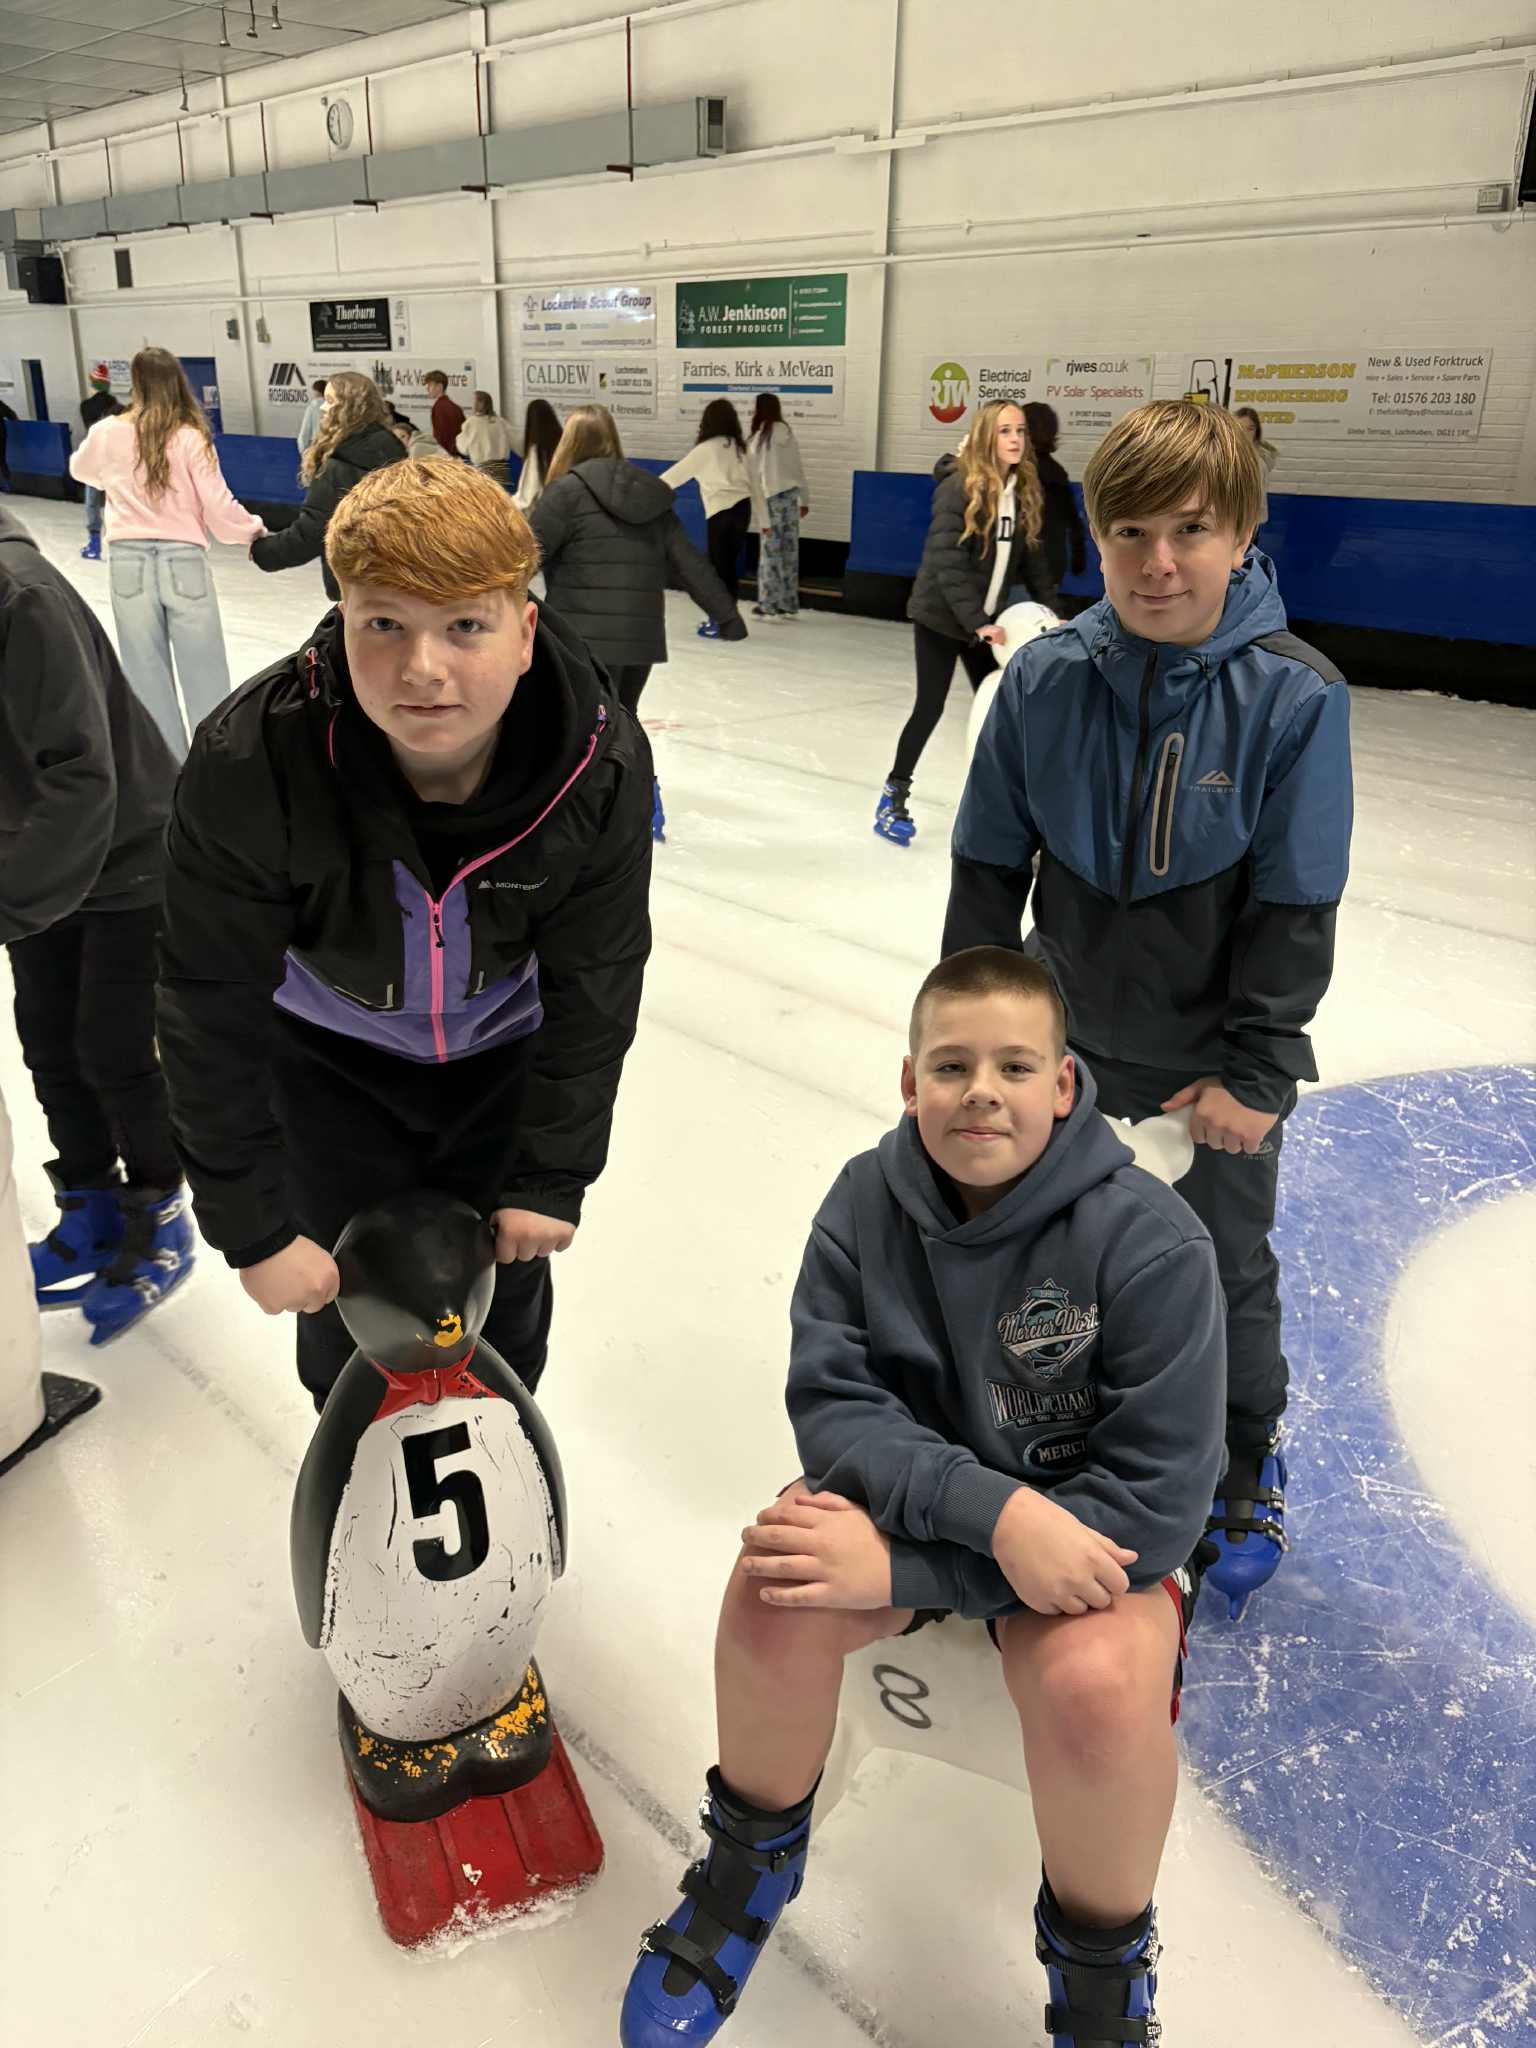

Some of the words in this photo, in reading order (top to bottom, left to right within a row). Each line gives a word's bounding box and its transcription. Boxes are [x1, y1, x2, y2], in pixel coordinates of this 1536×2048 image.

[541, 297, 588, 311] Lockerbie
[590, 297, 619, 309] Scout
[620, 294, 653, 309] Group
[335, 304, 376, 320] Thorburn
[722, 304, 787, 321] Jenkinson
[700, 325, 732, 334] FOREST
[736, 324, 784, 334] PRODUCTS
[682, 361, 730, 377] Farries,
[735, 360, 763, 377] Kirk
[767, 364, 777, 377] &
[779, 360, 834, 378] McVean
[1066, 360, 1129, 376] rjwes.co.uk
[1368, 357, 1391, 367] New
[1393, 356, 1402, 367] &
[1404, 356, 1431, 367] Used
[1433, 355, 1485, 367] Forktruck
[395, 370, 412, 386] Ark
[526, 364, 590, 385] CALDEW
[979, 368, 1031, 382] Electrical
[1237, 363, 1356, 379] McPHERSON
[1462, 374, 1481, 382] Parts
[268, 388, 309, 403] ROBINSONS
[977, 385, 1027, 399] Services
[1046, 385, 1063, 397] PV
[1064, 385, 1089, 397] Solar
[1091, 384, 1144, 400] Specialists
[1234, 388, 1348, 403] ENGINEERING
[1371, 392, 1391, 404] Tel:
[1393, 392, 1429, 404] 01576
[1430, 392, 1452, 404] 203
[1454, 392, 1477, 404] 180
[998, 1311, 1058, 1345] Mercier
[988, 1382, 1042, 1425] WORLD
[1048, 1382, 1098, 1415] CHAMP
[1038, 1440, 1088, 1464] MERCI
[401, 1420, 490, 1582] 5
[872, 1663, 933, 1730] 8
